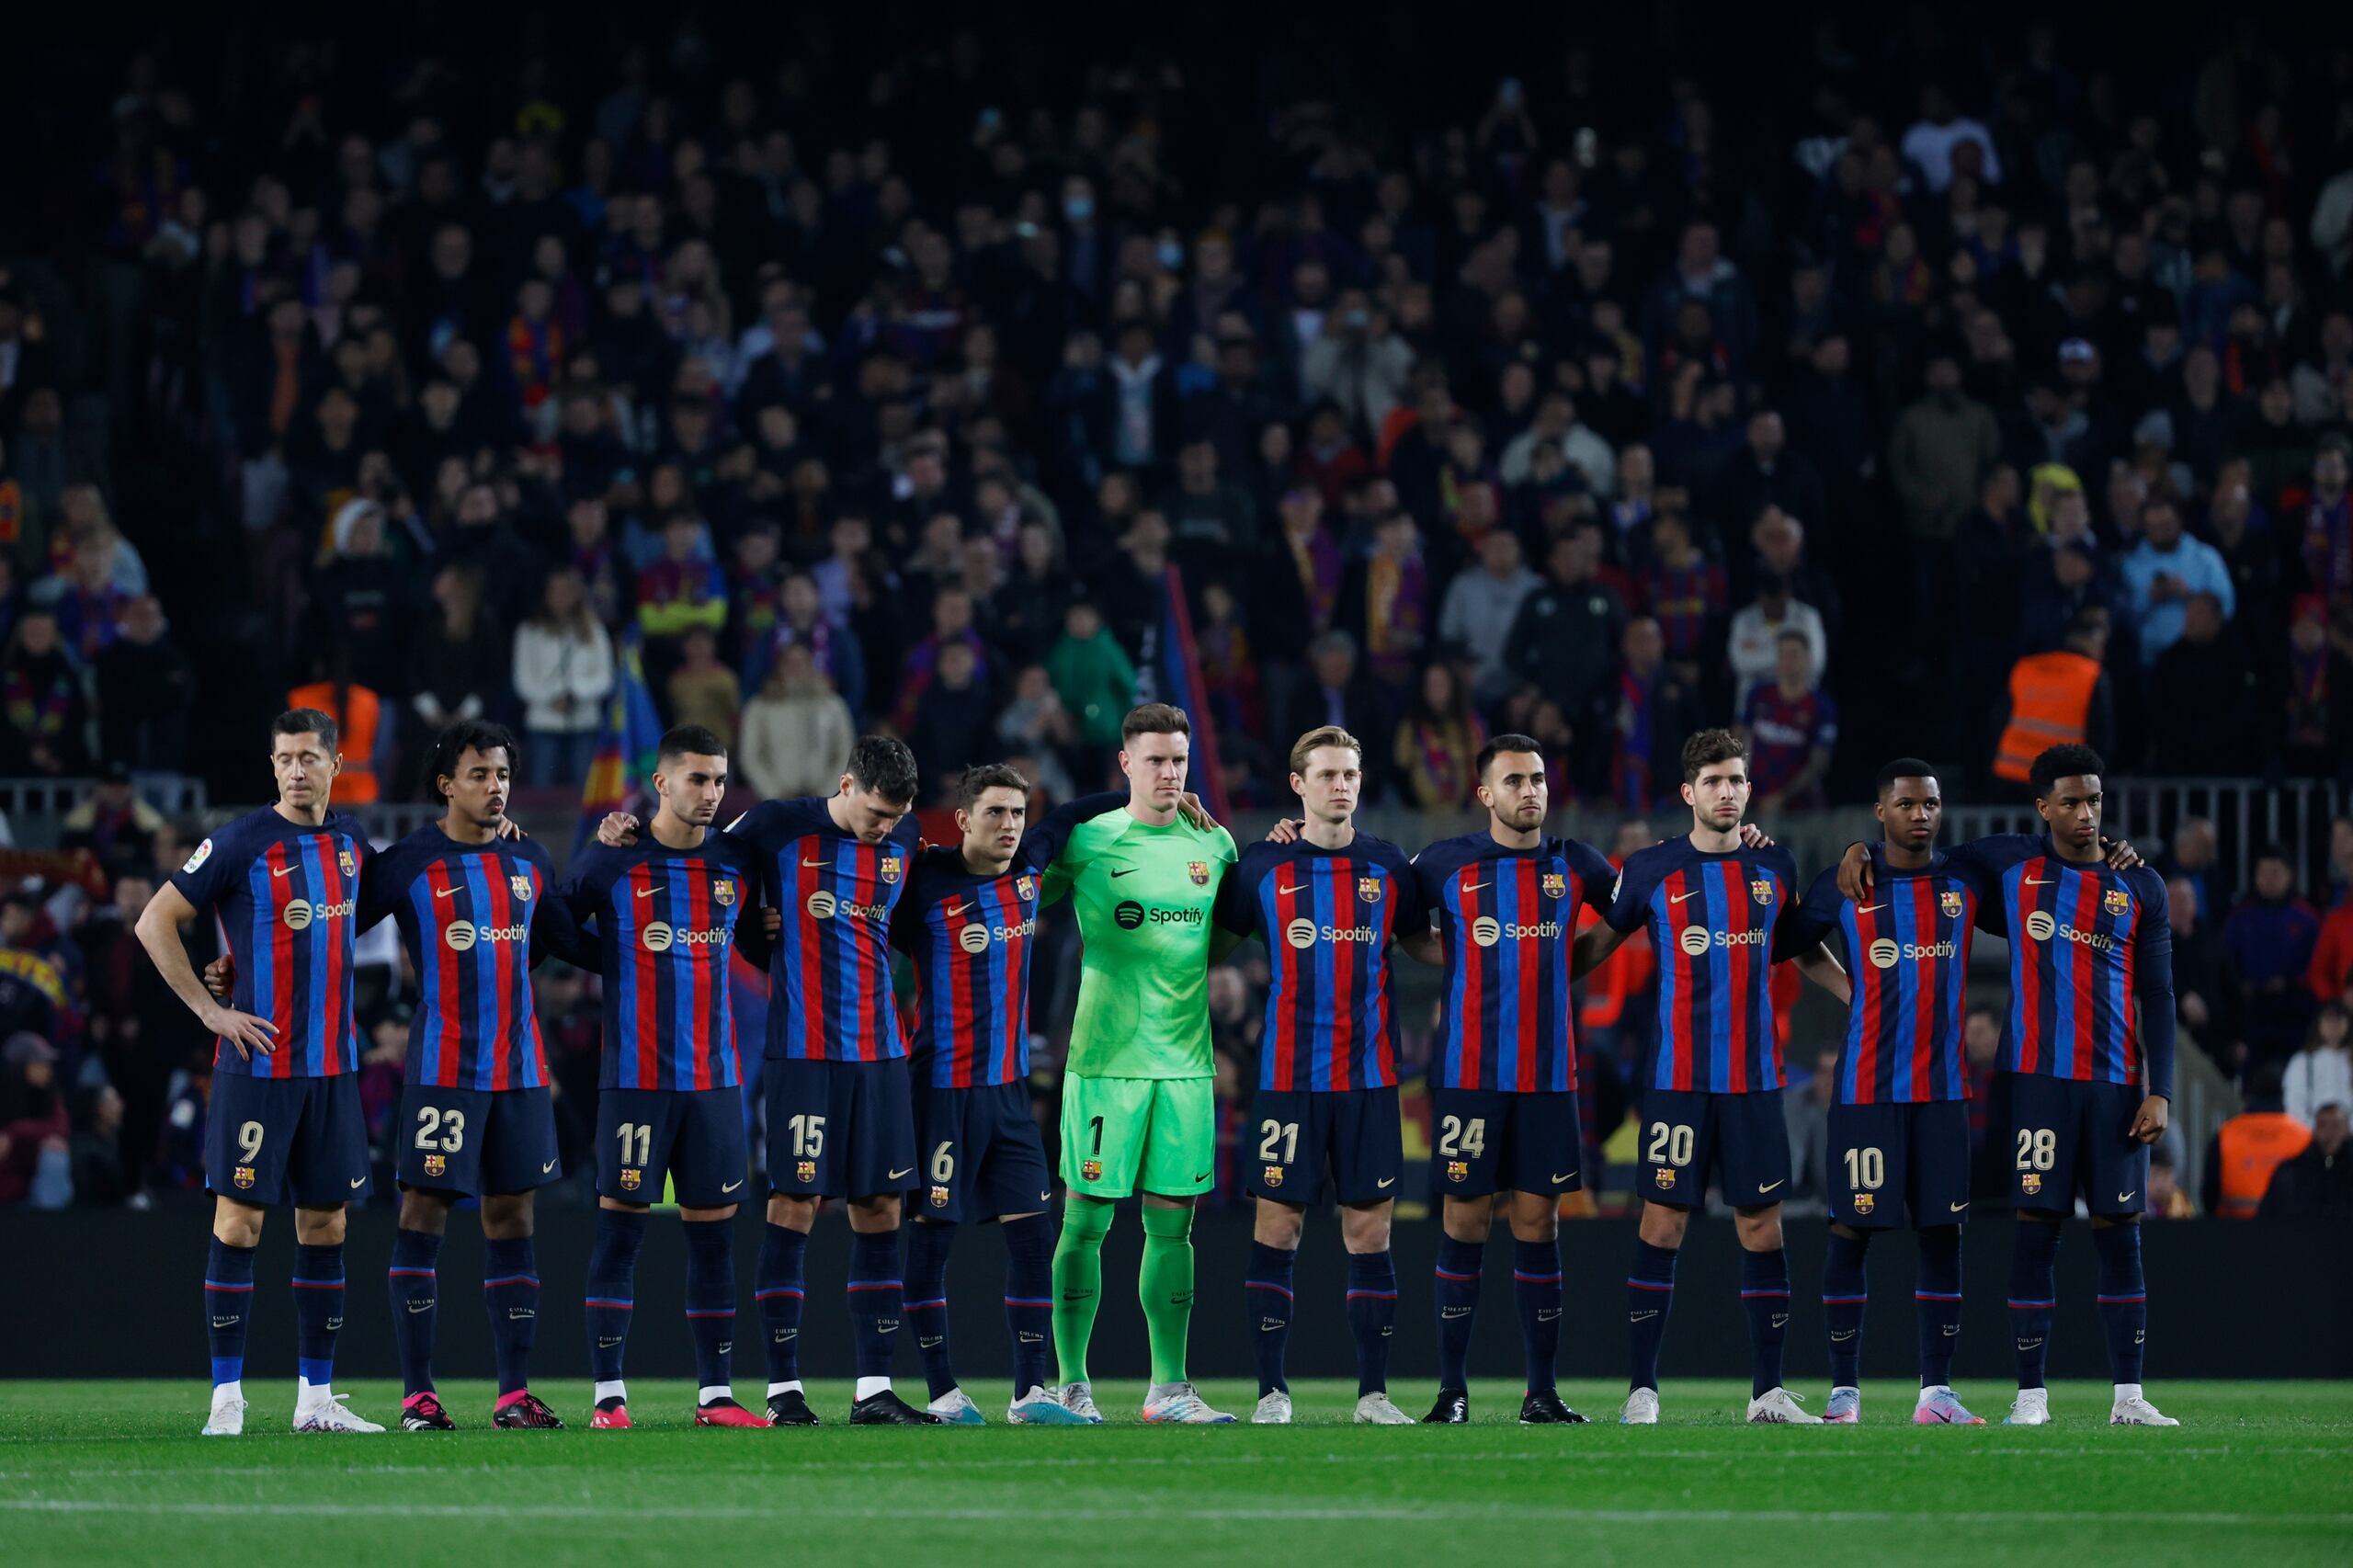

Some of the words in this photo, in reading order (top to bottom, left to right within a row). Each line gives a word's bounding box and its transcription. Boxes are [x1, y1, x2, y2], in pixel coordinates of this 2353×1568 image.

[315, 899, 354, 920] Spotify
[839, 900, 889, 922] Spotify
[1149, 907, 1205, 925] Spotify
[480, 924, 529, 943] Spotify
[676, 927, 730, 946] Spotify
[993, 918, 1036, 942] Spotify
[1321, 925, 1378, 945] Spotify
[1505, 920, 1563, 940] Spotify
[1714, 930, 1768, 948] Spotify
[2059, 924, 2114, 950] Spotify
[1904, 940, 1957, 960] Spotify
[238, 1120, 265, 1164] 9
[415, 1106, 465, 1153] 23
[617, 1122, 652, 1166] 11
[788, 1114, 826, 1158] 15
[1088, 1115, 1104, 1156] 1
[1258, 1119, 1300, 1165] 21
[1438, 1115, 1486, 1159] 24
[1647, 1121, 1695, 1167] 20
[930, 1141, 954, 1183] 6
[2016, 1128, 2057, 1171] 28
[1844, 1146, 1884, 1190] 10
